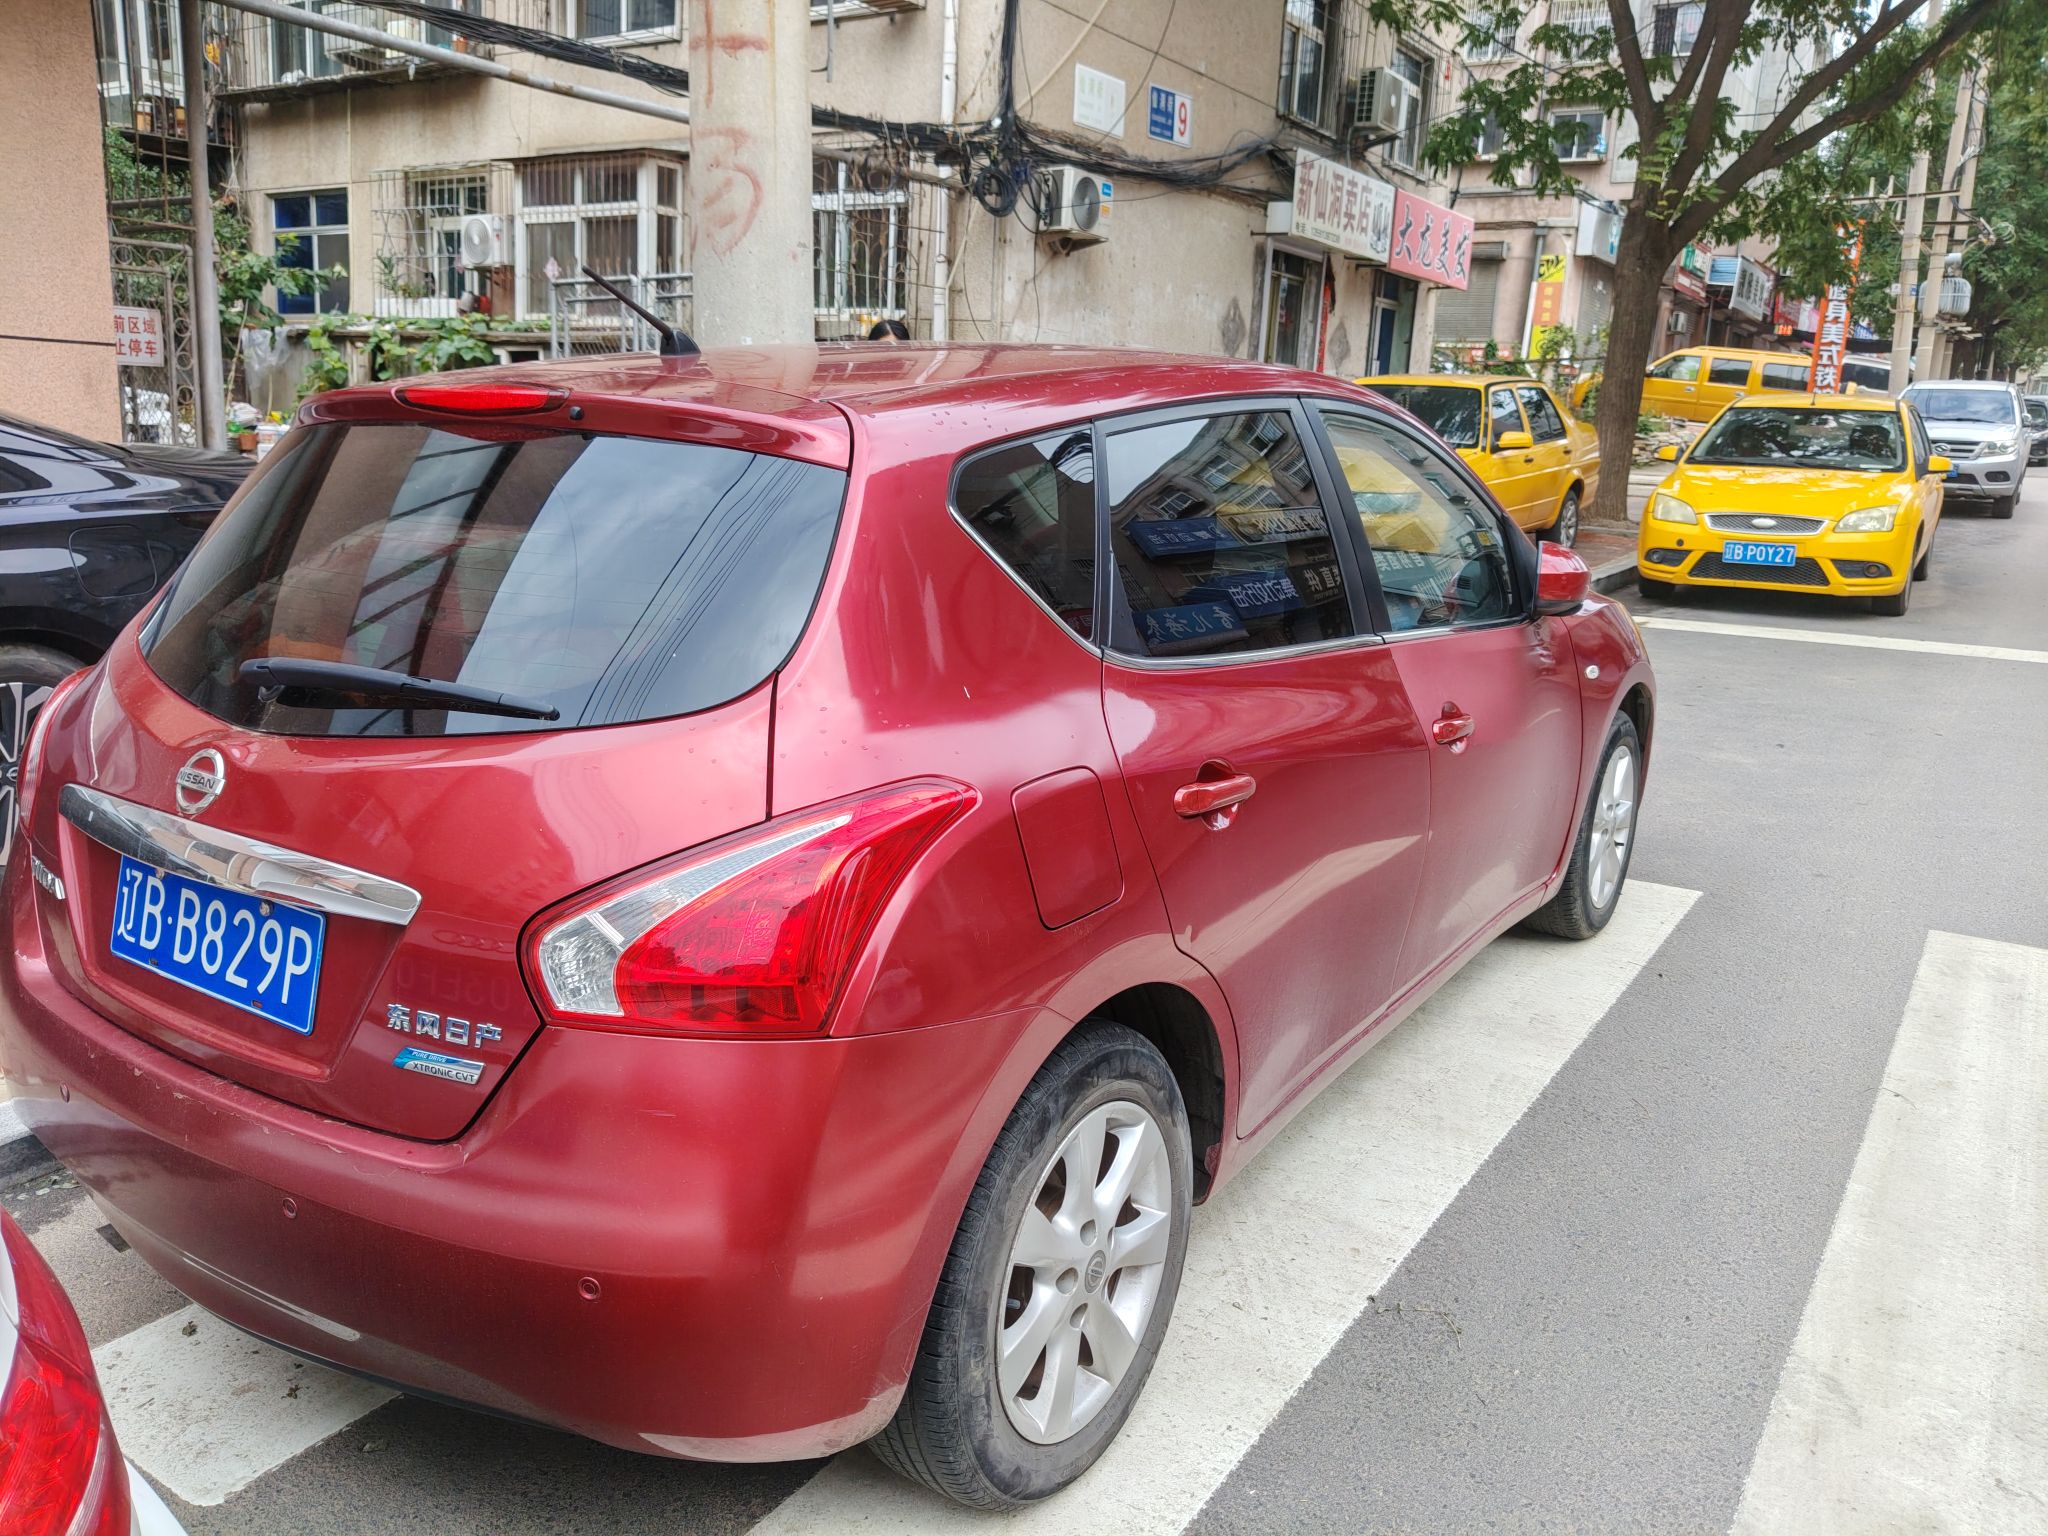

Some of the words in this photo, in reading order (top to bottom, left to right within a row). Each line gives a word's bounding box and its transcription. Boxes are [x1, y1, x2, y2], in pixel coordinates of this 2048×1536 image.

[1178, 101, 1188, 137] 9
[1296, 155, 1373, 237] 新仙洞卖店
[178, 769, 216, 790] NISSAN
[387, 1003, 502, 1048] 东风日产
[412, 1061, 454, 1078] XTRONIC
[455, 1070, 476, 1083] CVT
